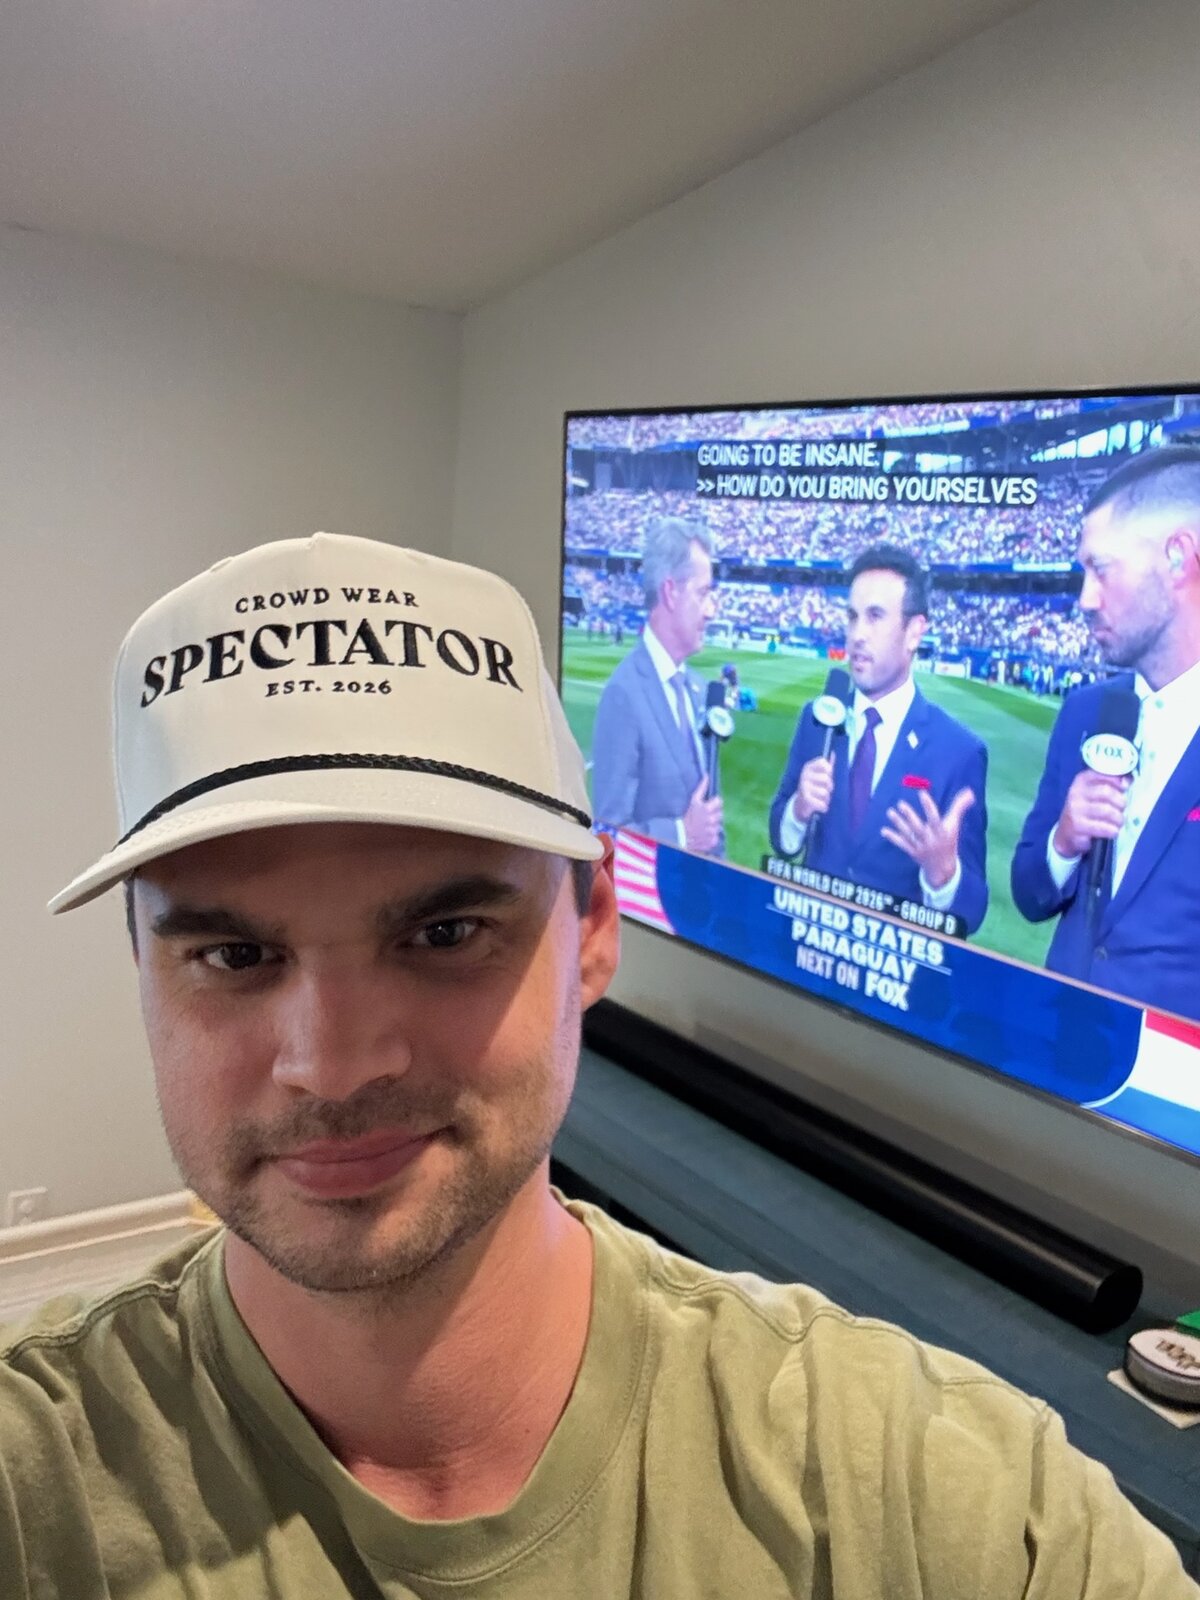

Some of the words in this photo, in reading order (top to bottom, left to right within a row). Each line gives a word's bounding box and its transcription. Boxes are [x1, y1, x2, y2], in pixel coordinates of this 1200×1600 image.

[698, 443, 750, 467] GOING
[752, 443, 776, 467] TO
[778, 443, 803, 468] BE
[805, 442, 880, 468] INSANE.
[696, 478, 716, 493] >>
[717, 474, 759, 497] HOW
[759, 475, 786, 499] DO
[788, 475, 827, 499] YOU
[828, 475, 889, 501] BRING
[893, 475, 1039, 505] YOURSELVES
[234, 587, 331, 614] CROWD
[341, 587, 420, 608] WEAR
[140, 618, 524, 708] SPECTATOR
[265, 679, 322, 697] EST.
[332, 678, 393, 695] 2026
[767, 856, 792, 880] FIFA
[792, 866, 831, 893] WORLD
[831, 877, 855, 900] CUP
[900, 900, 944, 930] GROUP
[944, 914, 957, 935] D
[773, 885, 850, 932] UNITED
[851, 913, 944, 967] STATES
[791, 918, 918, 984] PARAGUAY
[796, 944, 836, 980] NEXT
[836, 960, 860, 991] ON
[864, 969, 910, 1012] FOX
